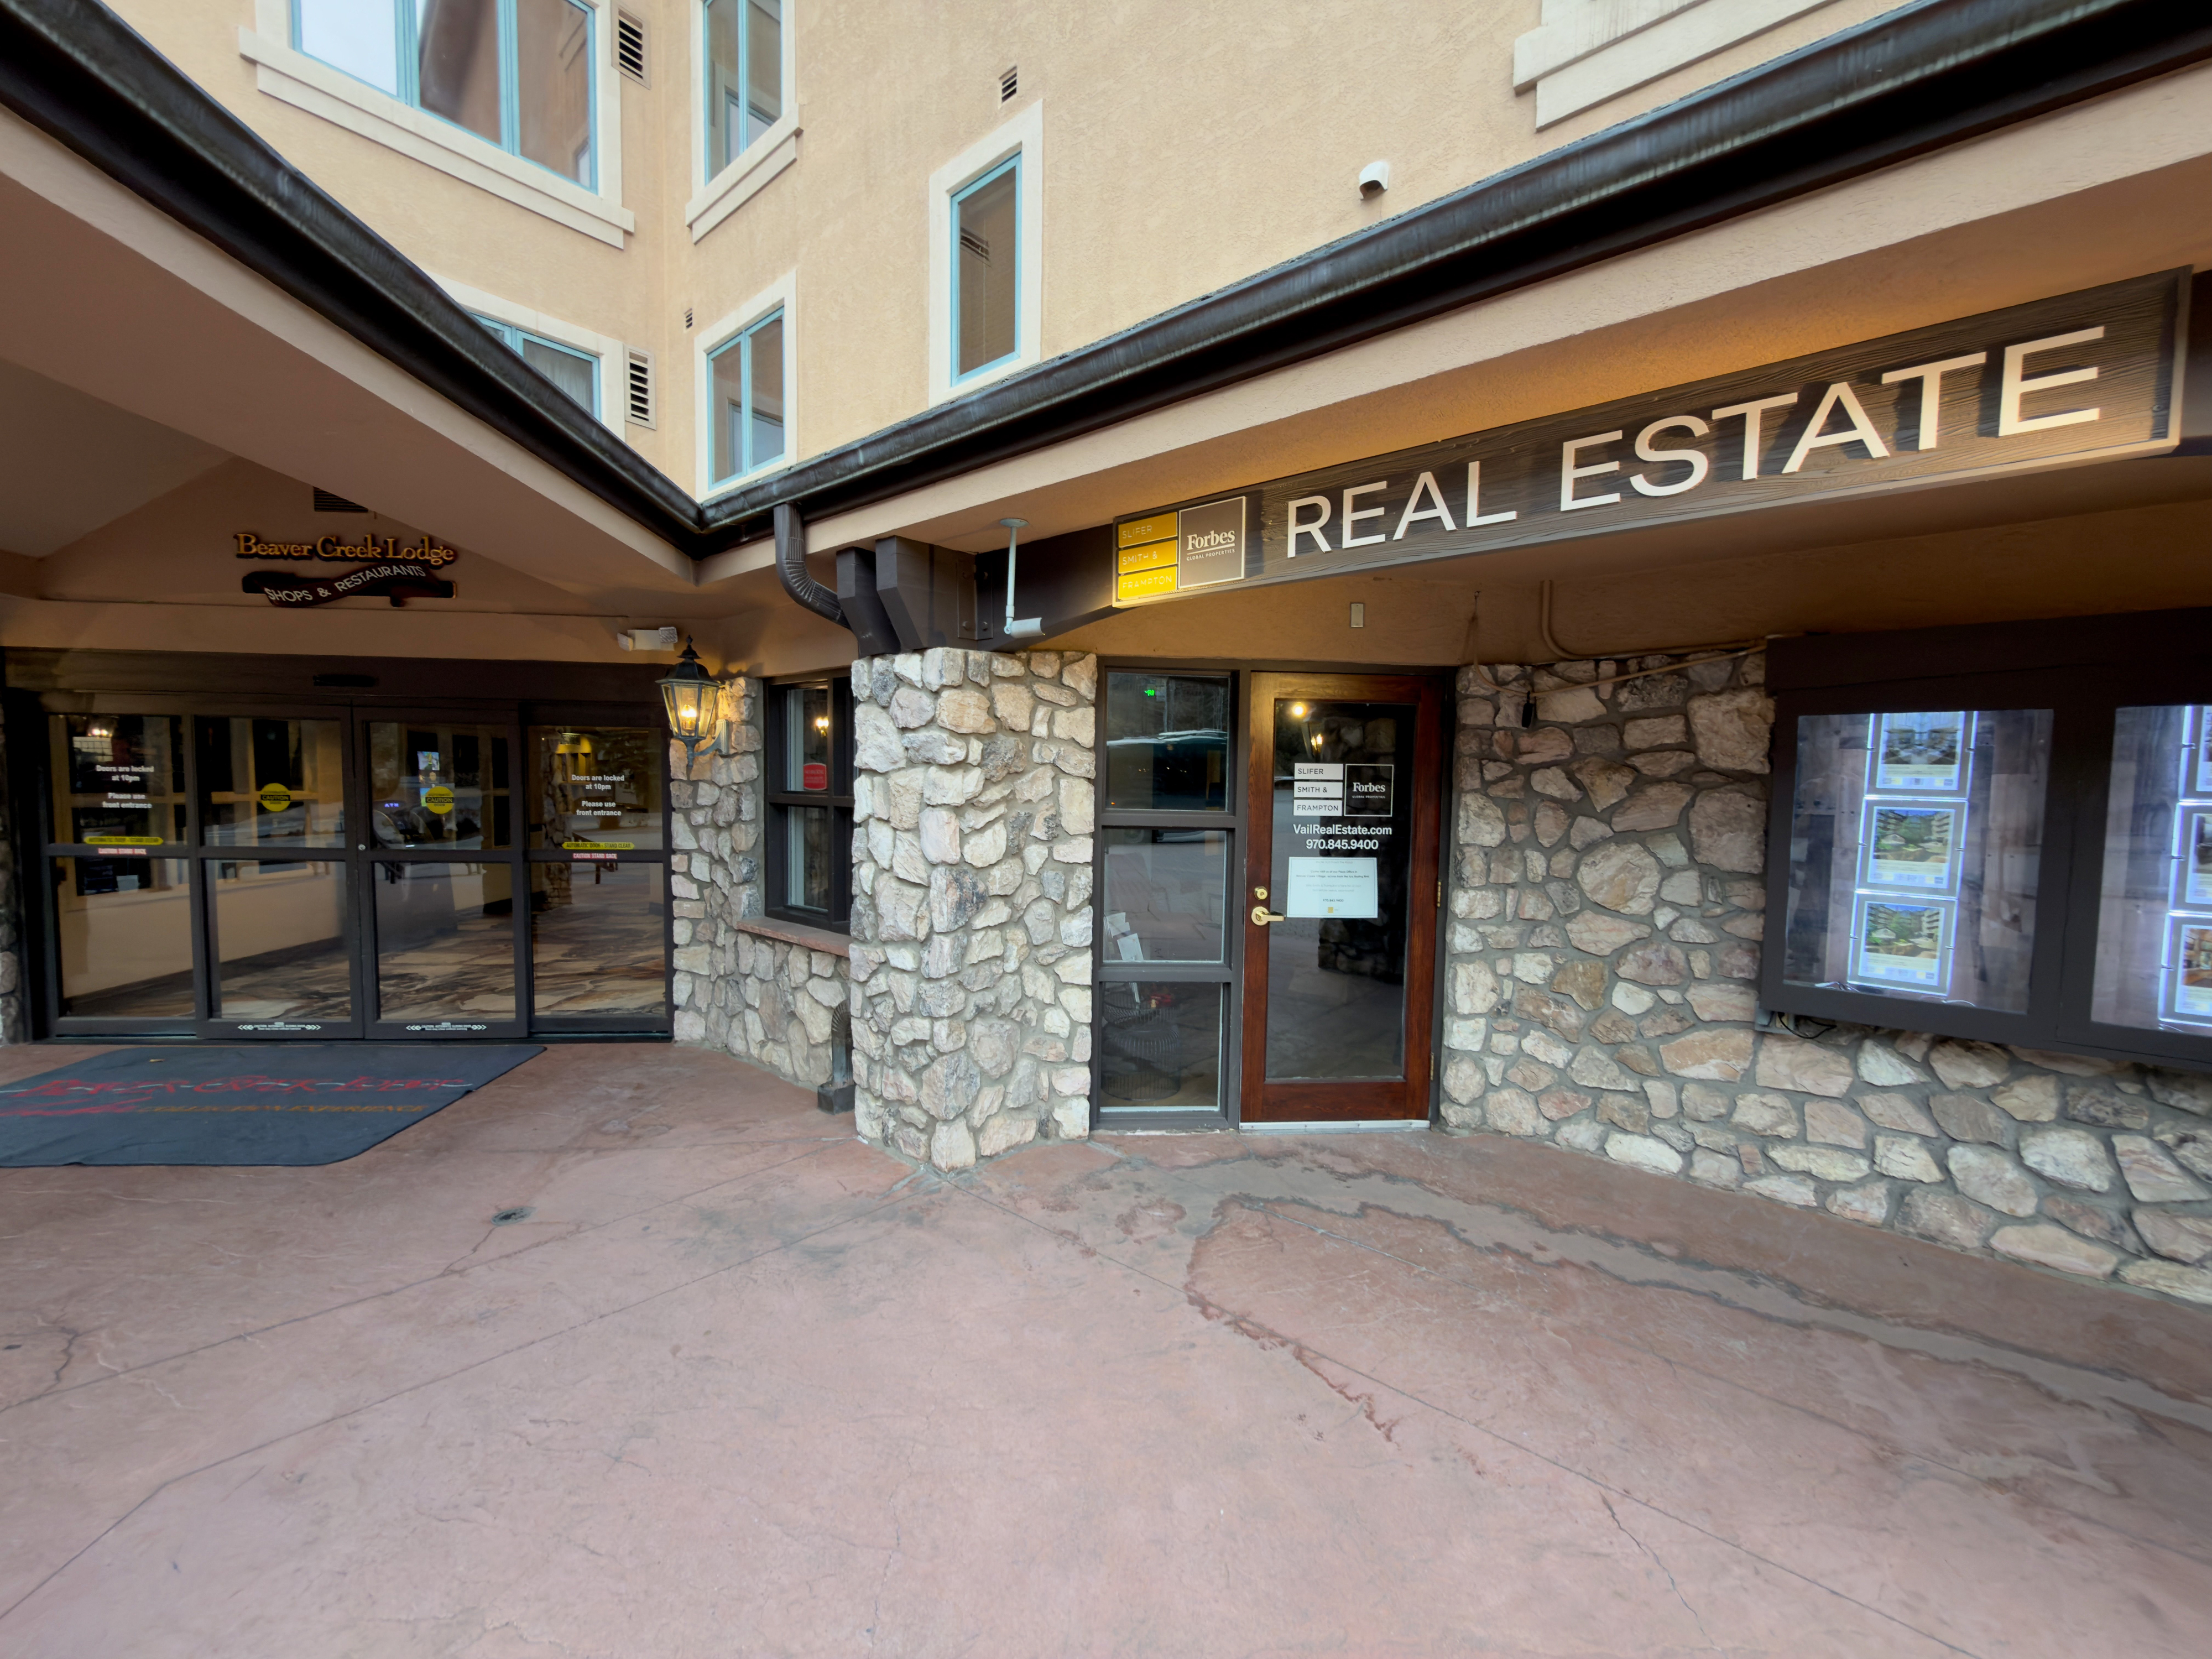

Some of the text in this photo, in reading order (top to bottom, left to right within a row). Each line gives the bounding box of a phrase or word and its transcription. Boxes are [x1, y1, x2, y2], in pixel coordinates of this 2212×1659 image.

[1286, 325, 2105, 557] REAL ESTATE
[1122, 525, 1152, 539] SLIFER
[1187, 530, 1235, 550] Forbes
[235, 533, 455, 565] Beaver Creek Lodge
[1206, 548, 1235, 558] PROPERTIES
[1122, 551, 1157, 565] SMITH &
[264, 565, 426, 602] SHOPS & RESTAURANTS
[1123, 575, 1172, 590] FRAMPTON
[1353, 782, 1385, 792] Forbes
[1293, 824, 1392, 835] VailRealEstate.com
[1306, 839, 1379, 850] 970.845.9400
